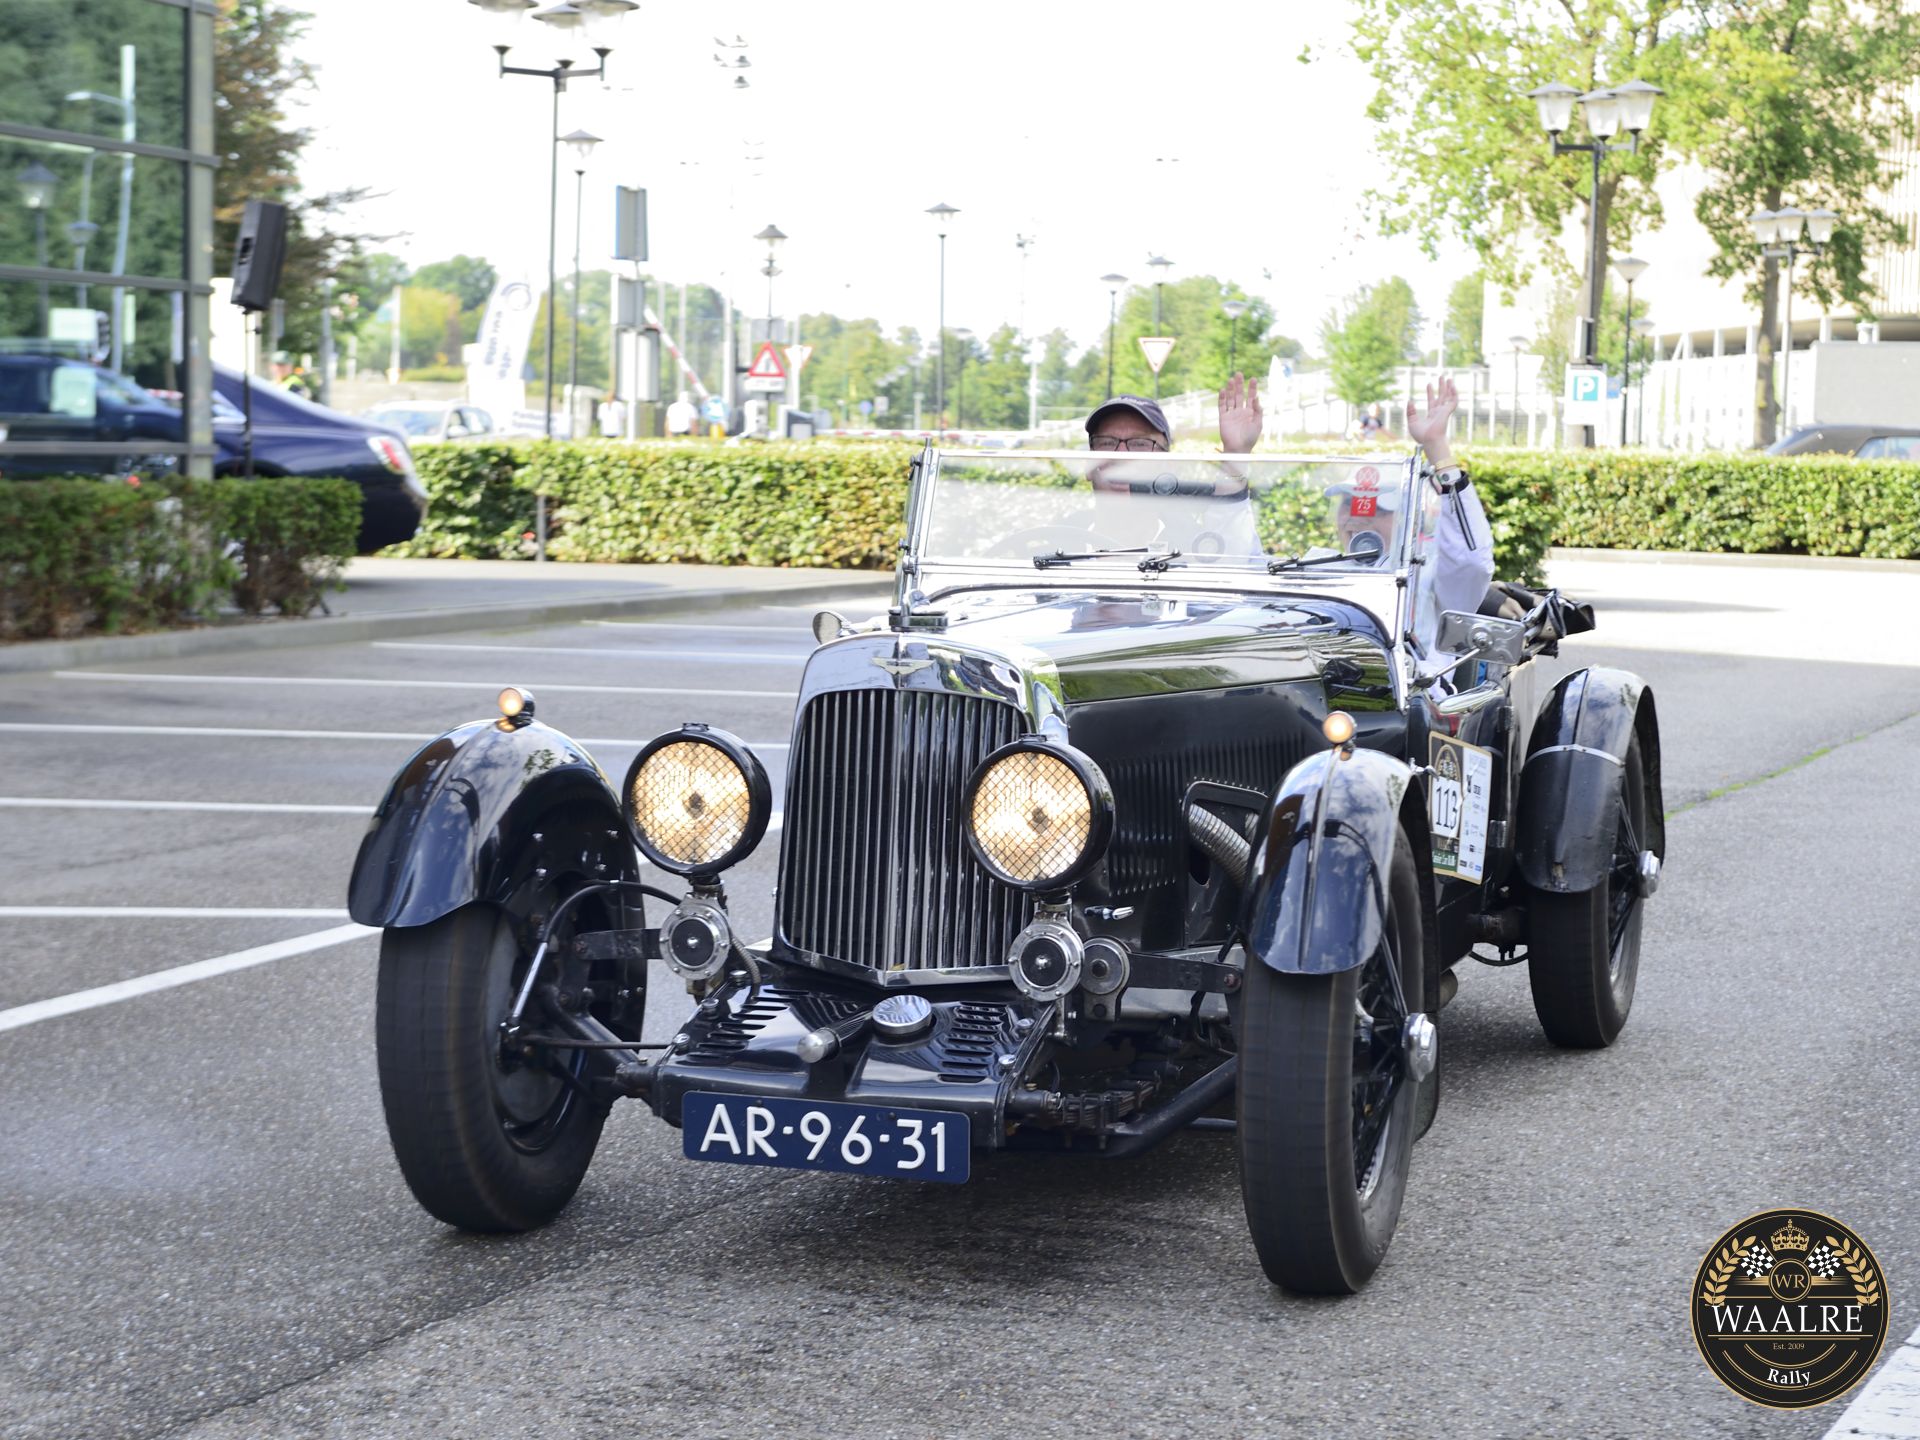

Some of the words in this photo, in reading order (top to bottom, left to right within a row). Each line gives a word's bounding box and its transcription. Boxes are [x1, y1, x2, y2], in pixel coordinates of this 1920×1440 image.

[1577, 376, 1596, 400] P
[1357, 499, 1371, 511] 75
[1436, 786, 1458, 830] 113
